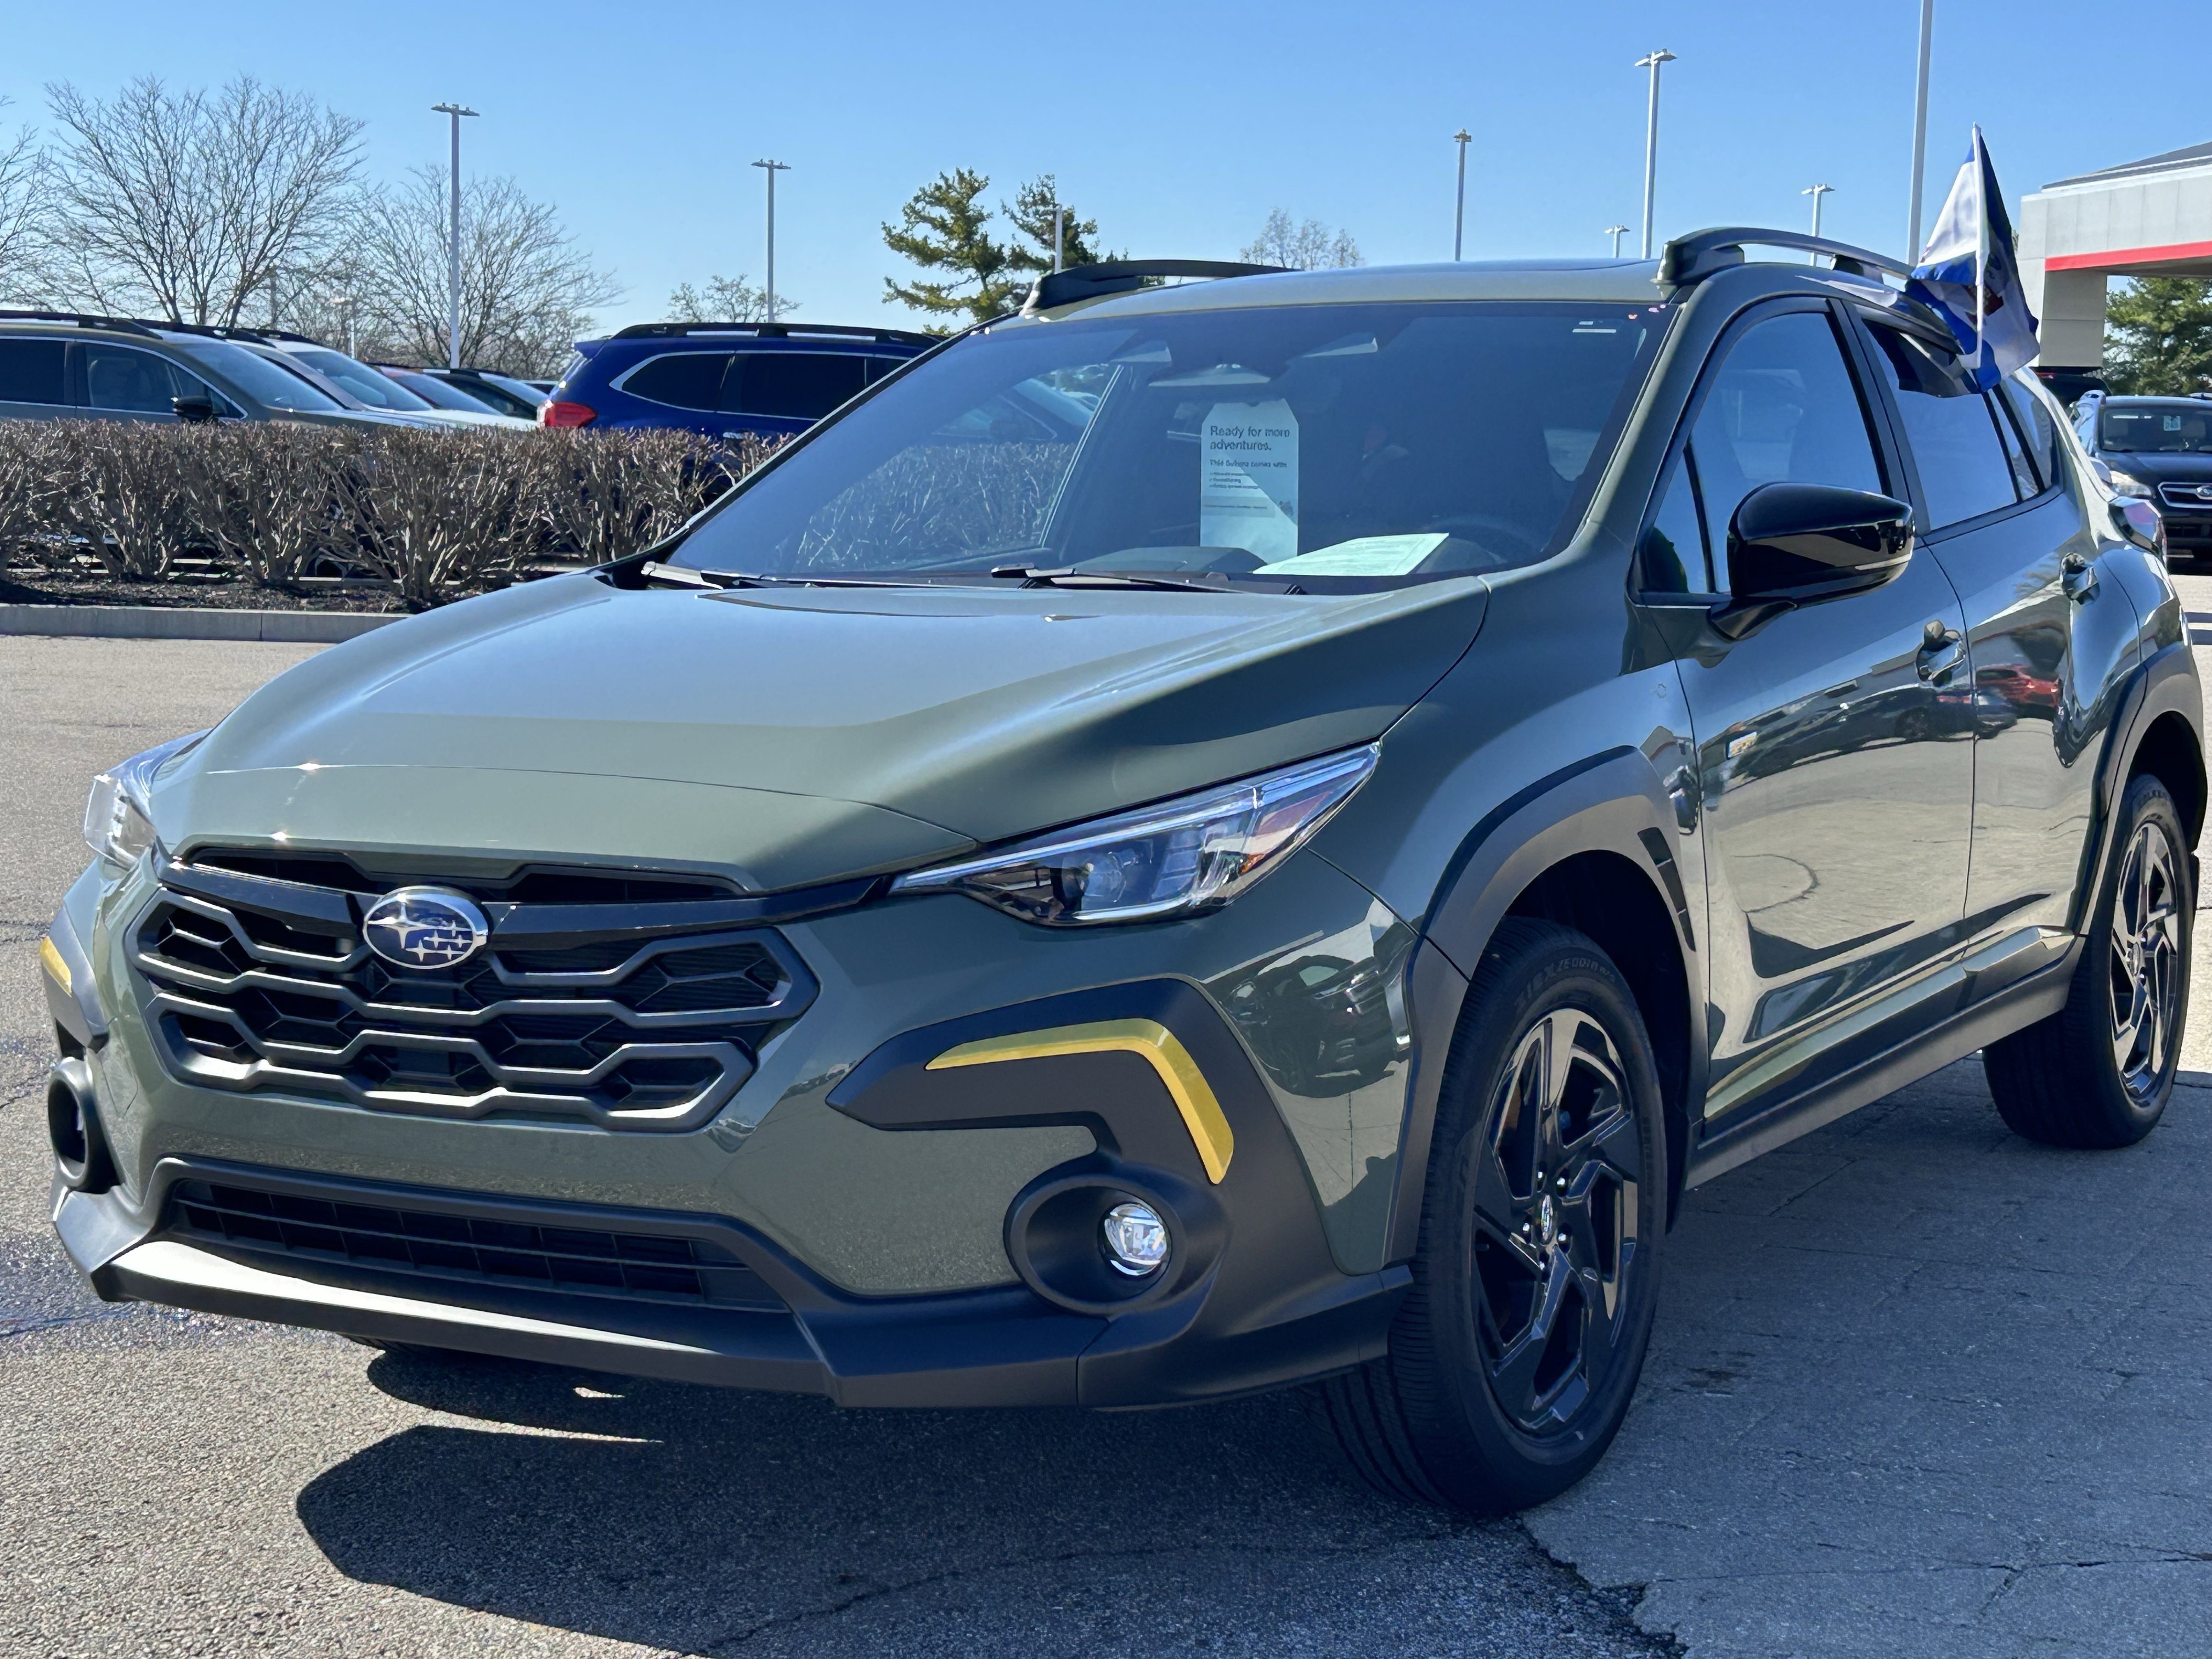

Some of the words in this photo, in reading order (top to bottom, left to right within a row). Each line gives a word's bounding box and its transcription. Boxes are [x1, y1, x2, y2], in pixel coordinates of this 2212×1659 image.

[1210, 425, 1244, 438] Ready
[1248, 426, 1262, 437] for
[1265, 428, 1290, 437] more
